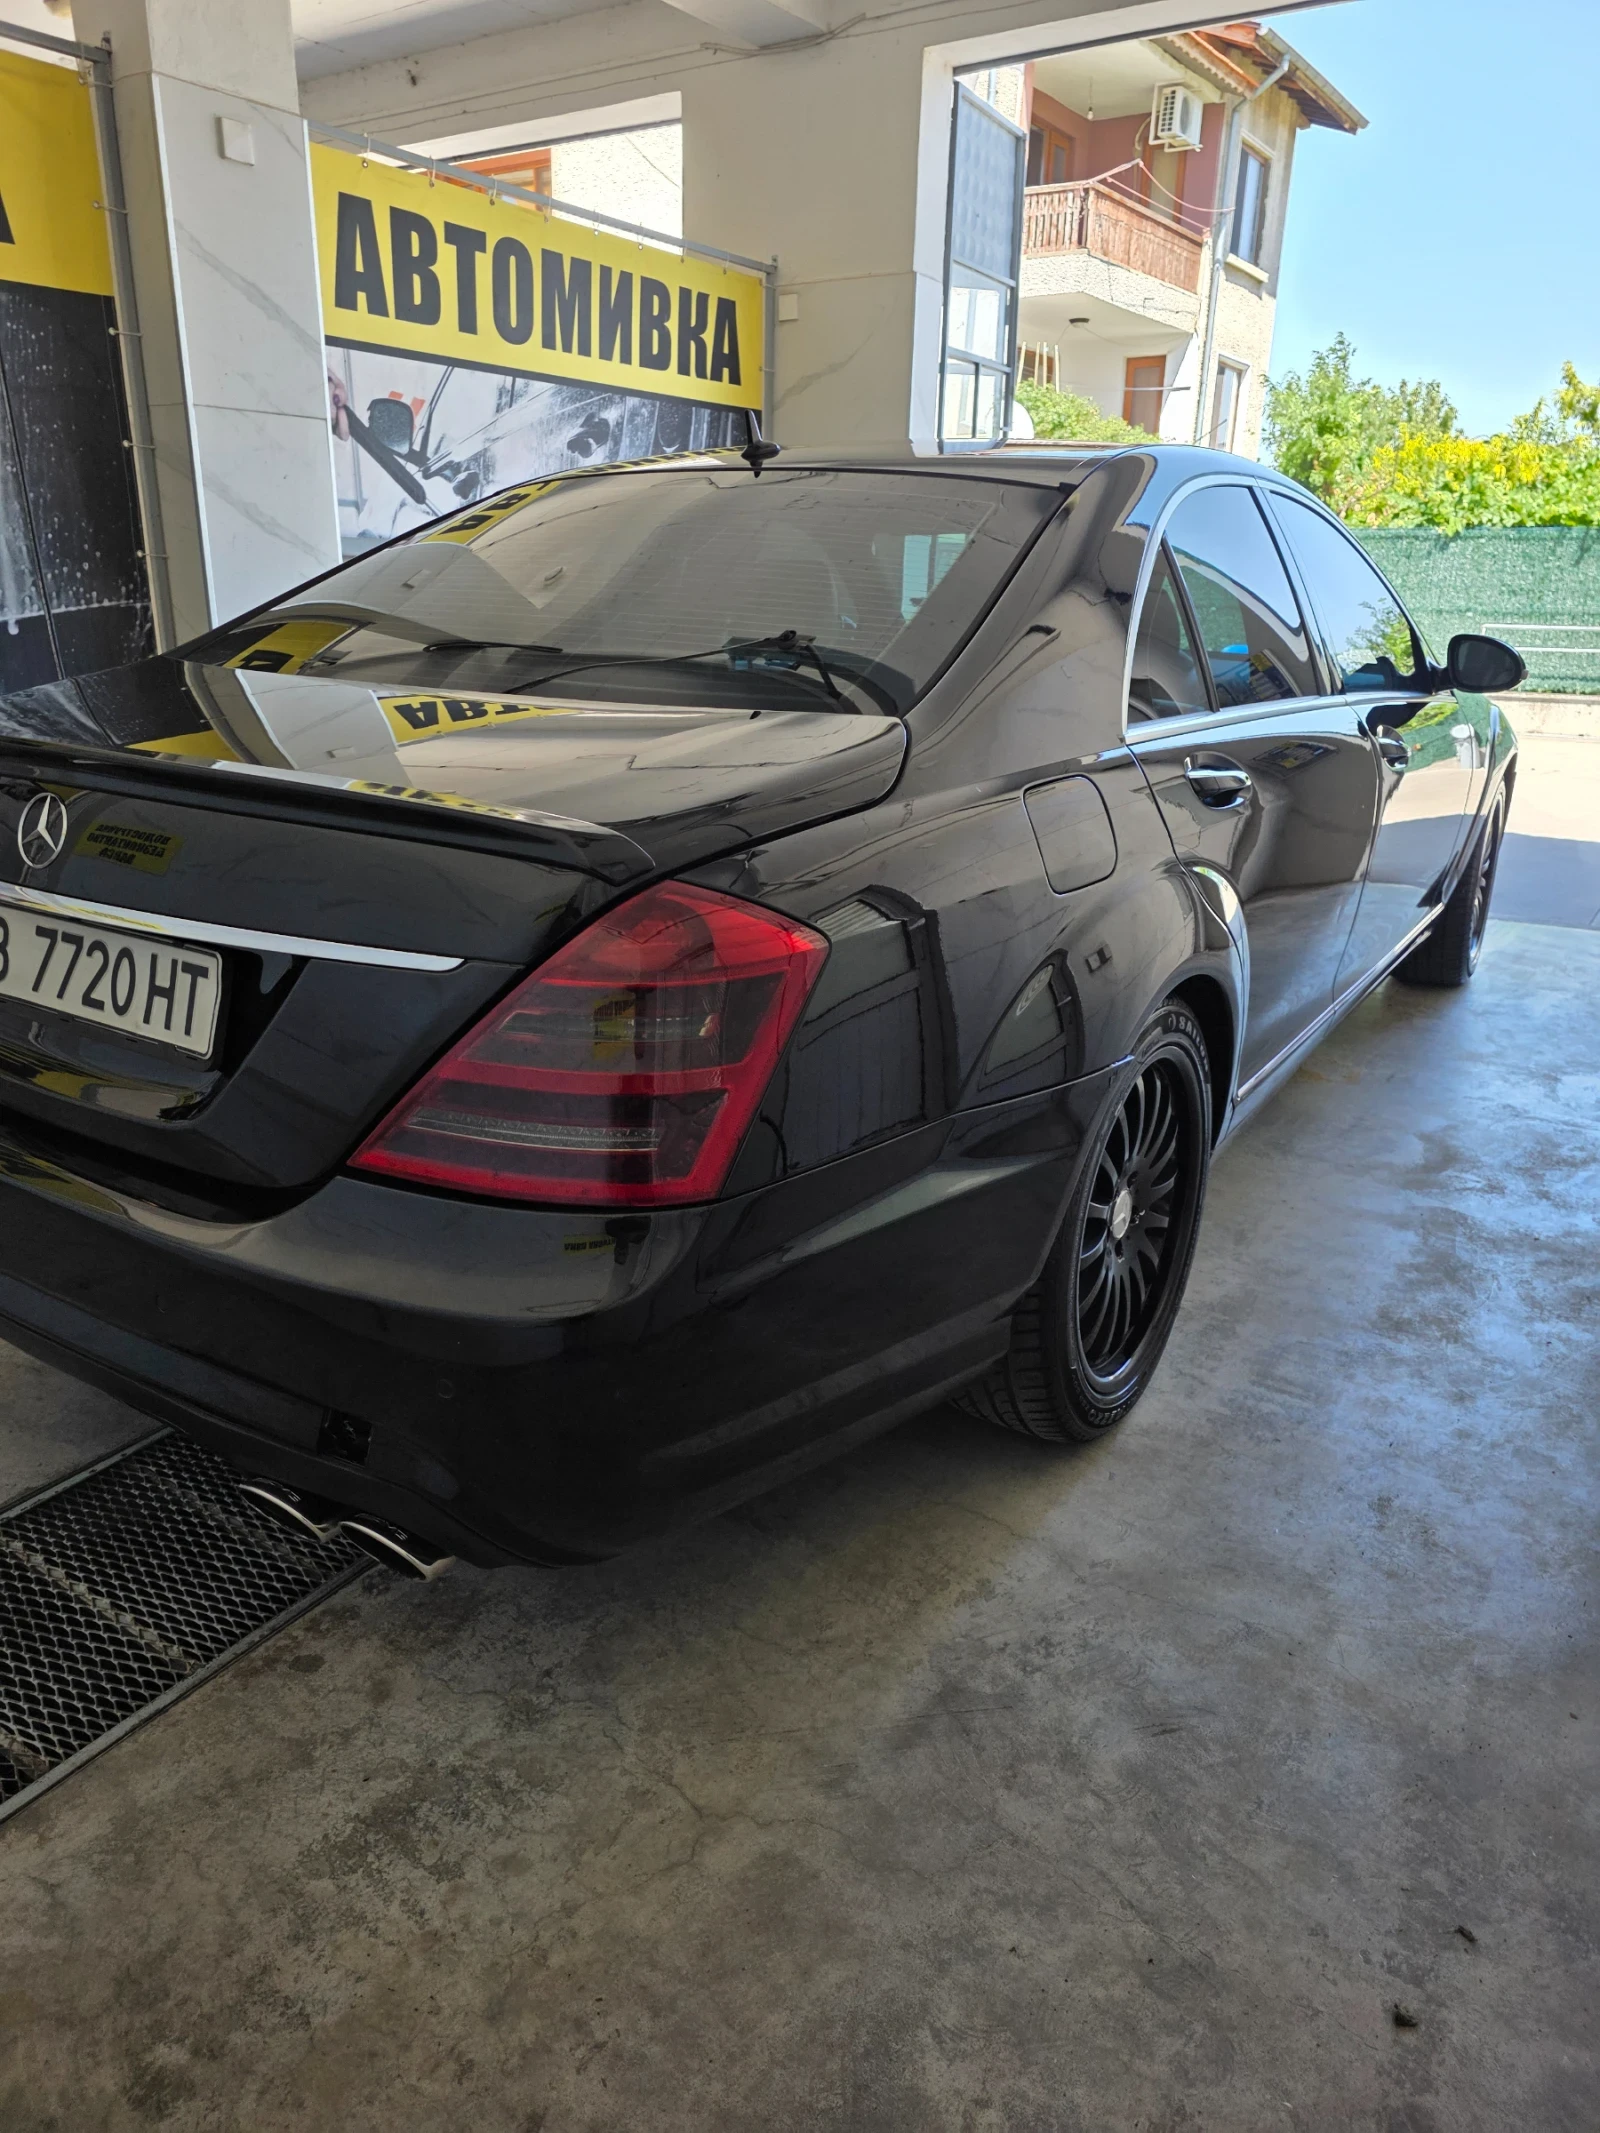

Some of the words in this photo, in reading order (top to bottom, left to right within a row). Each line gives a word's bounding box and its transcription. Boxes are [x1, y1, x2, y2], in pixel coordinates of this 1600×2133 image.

[334, 191, 742, 386] АВТОМИВКА
[31, 924, 137, 1016] 7720
[142, 952, 209, 1036] HT
